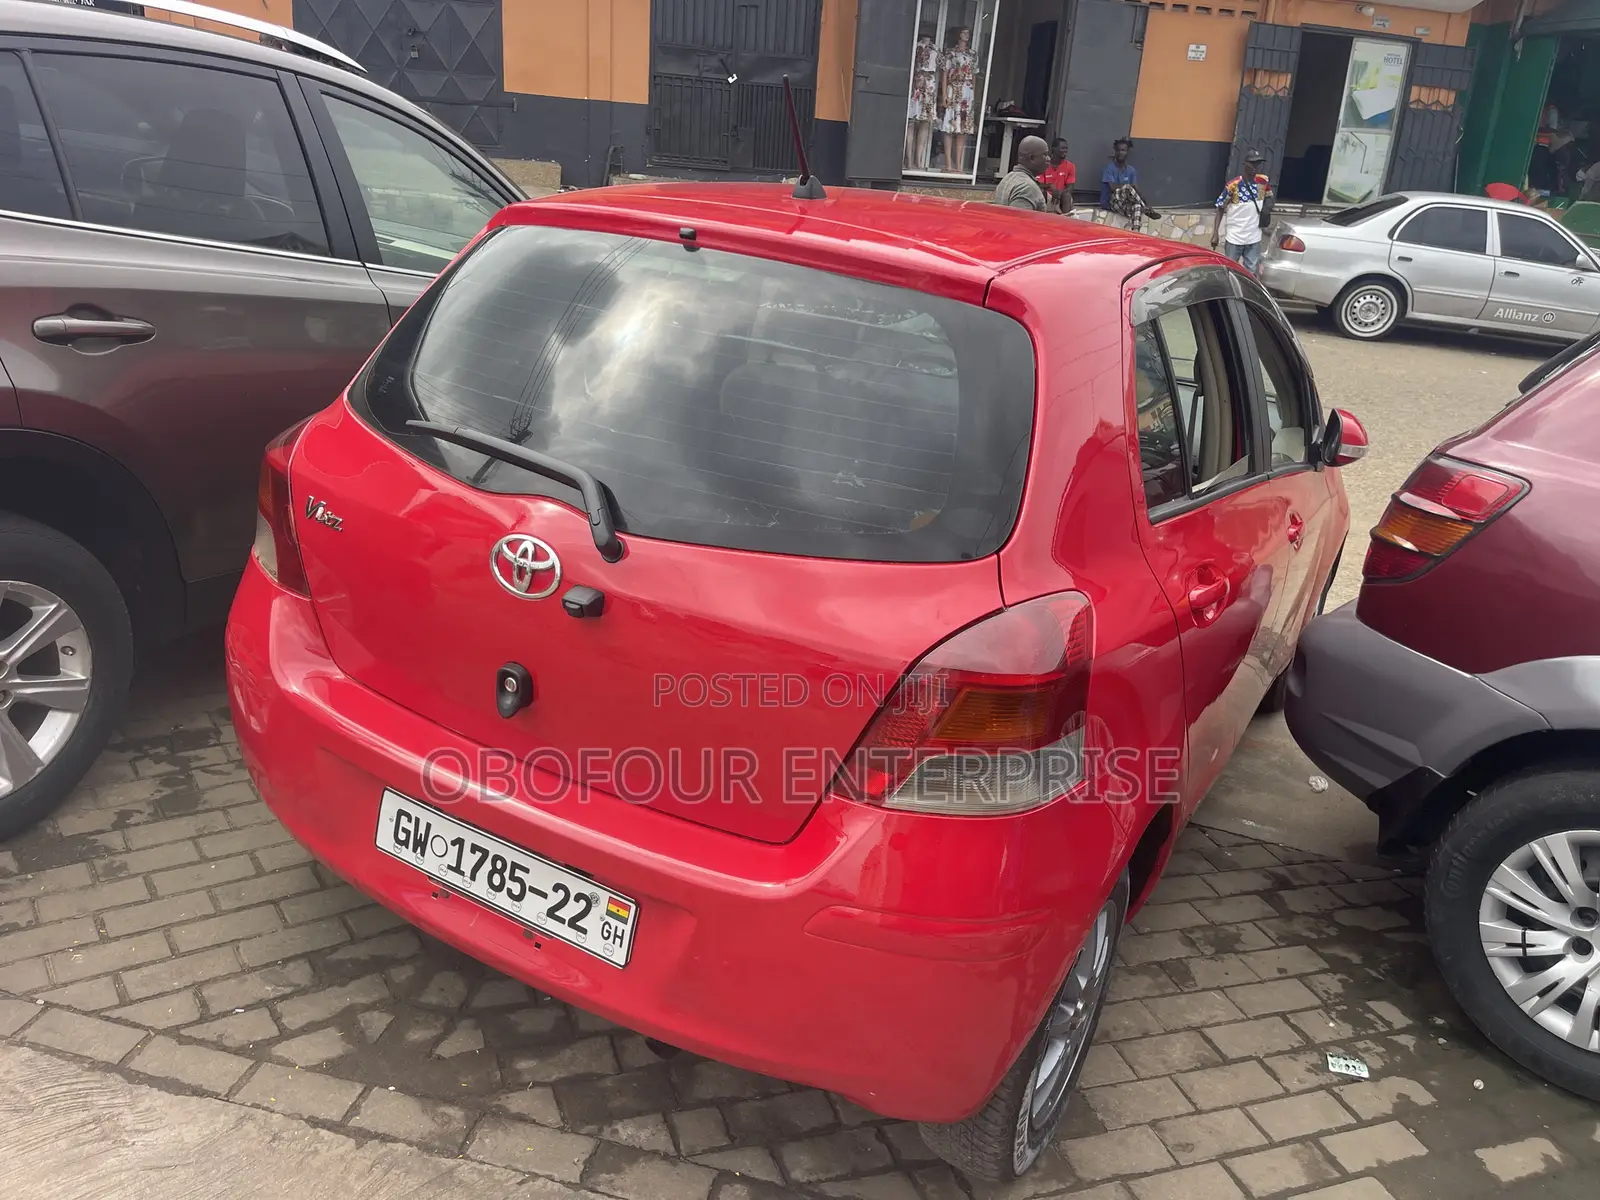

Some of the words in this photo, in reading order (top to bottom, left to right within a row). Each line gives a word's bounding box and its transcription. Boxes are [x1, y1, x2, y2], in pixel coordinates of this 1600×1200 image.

[1383, 55, 1403, 65] HOTEL
[1494, 308, 1540, 322] Allianz
[305, 495, 343, 532] Vitz
[393, 808, 432, 857] GW
[446, 836, 593, 935] 1785-22
[601, 920, 625, 948] GH
